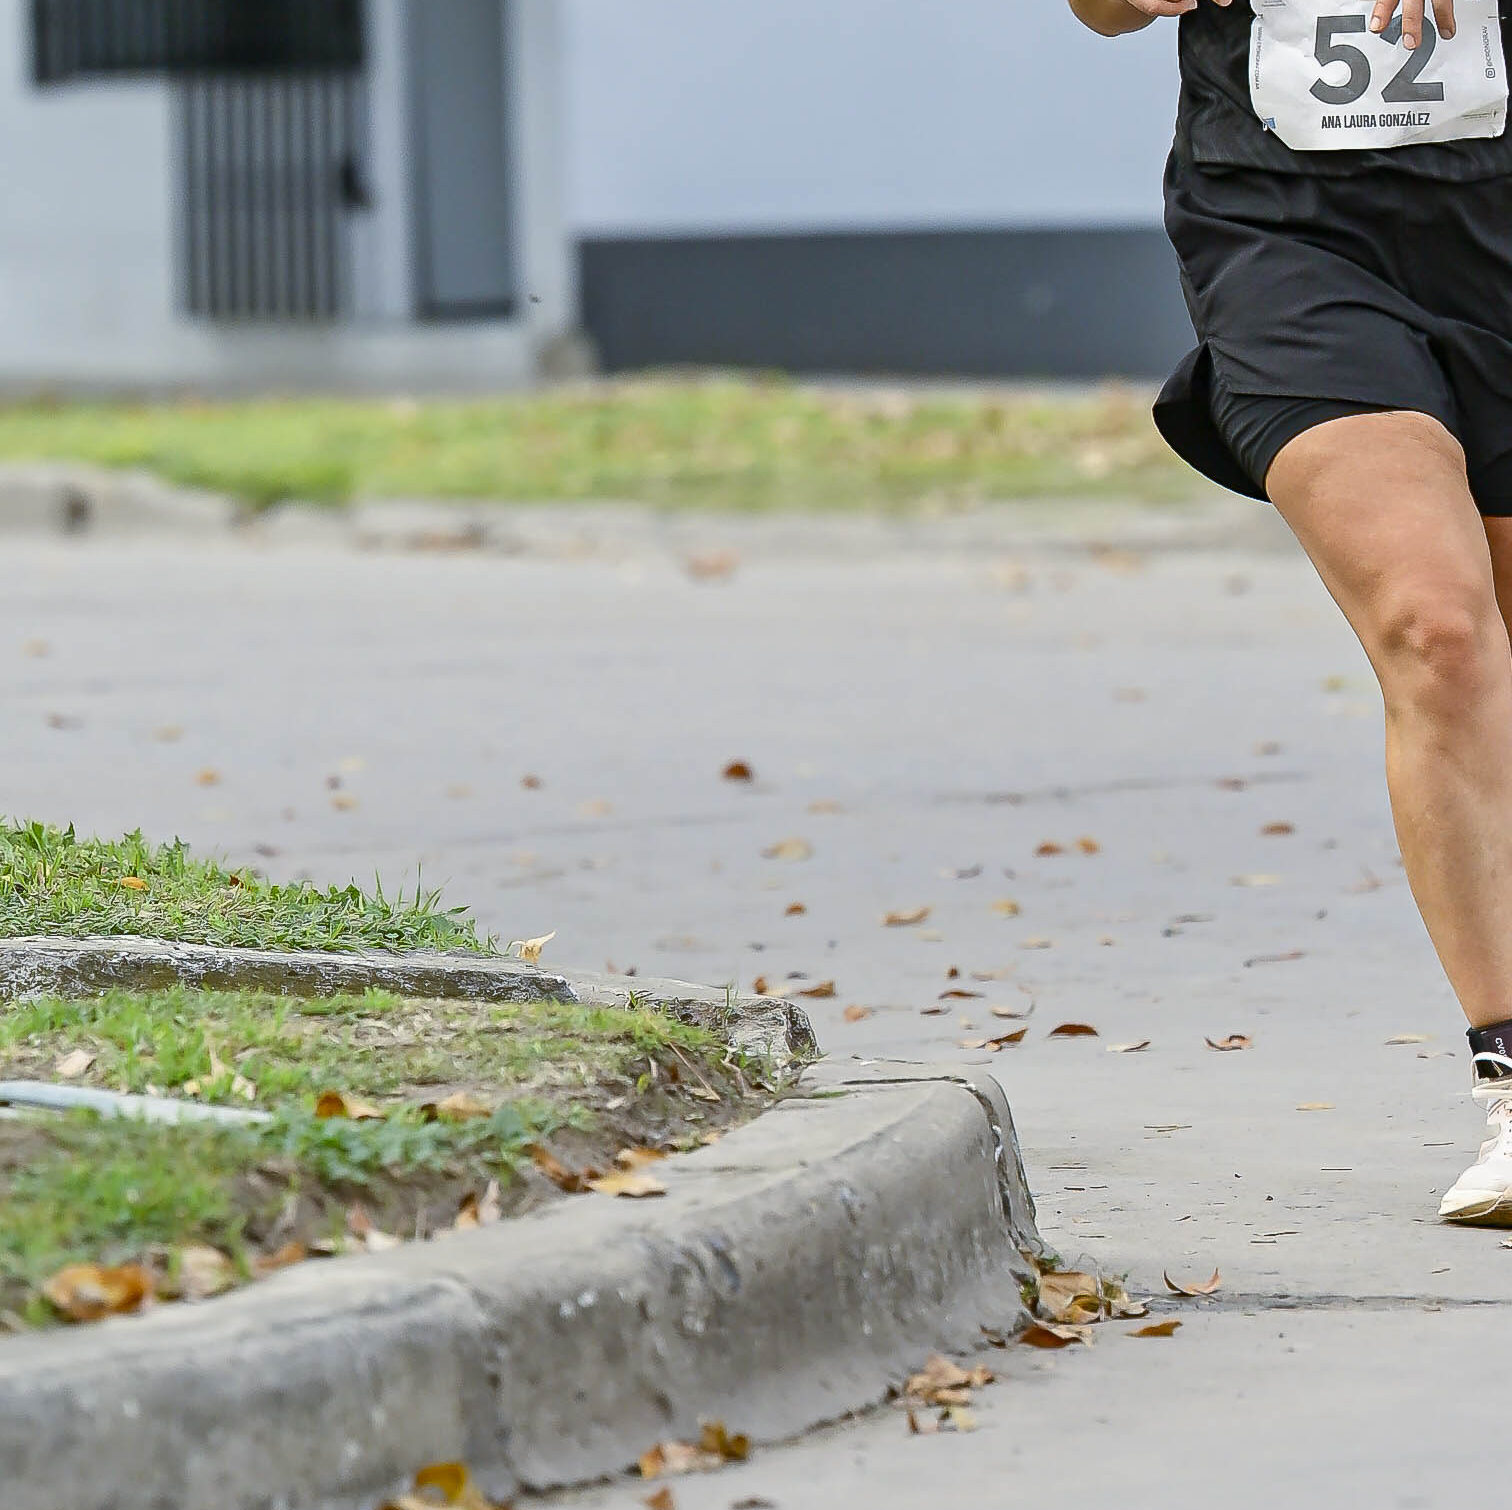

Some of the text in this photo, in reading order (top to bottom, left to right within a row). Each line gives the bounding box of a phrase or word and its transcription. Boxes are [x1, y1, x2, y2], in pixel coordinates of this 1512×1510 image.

[1309, 14, 1445, 105] 52
[1321, 110, 1431, 129] ANA LAURA GONZÁLEZ
